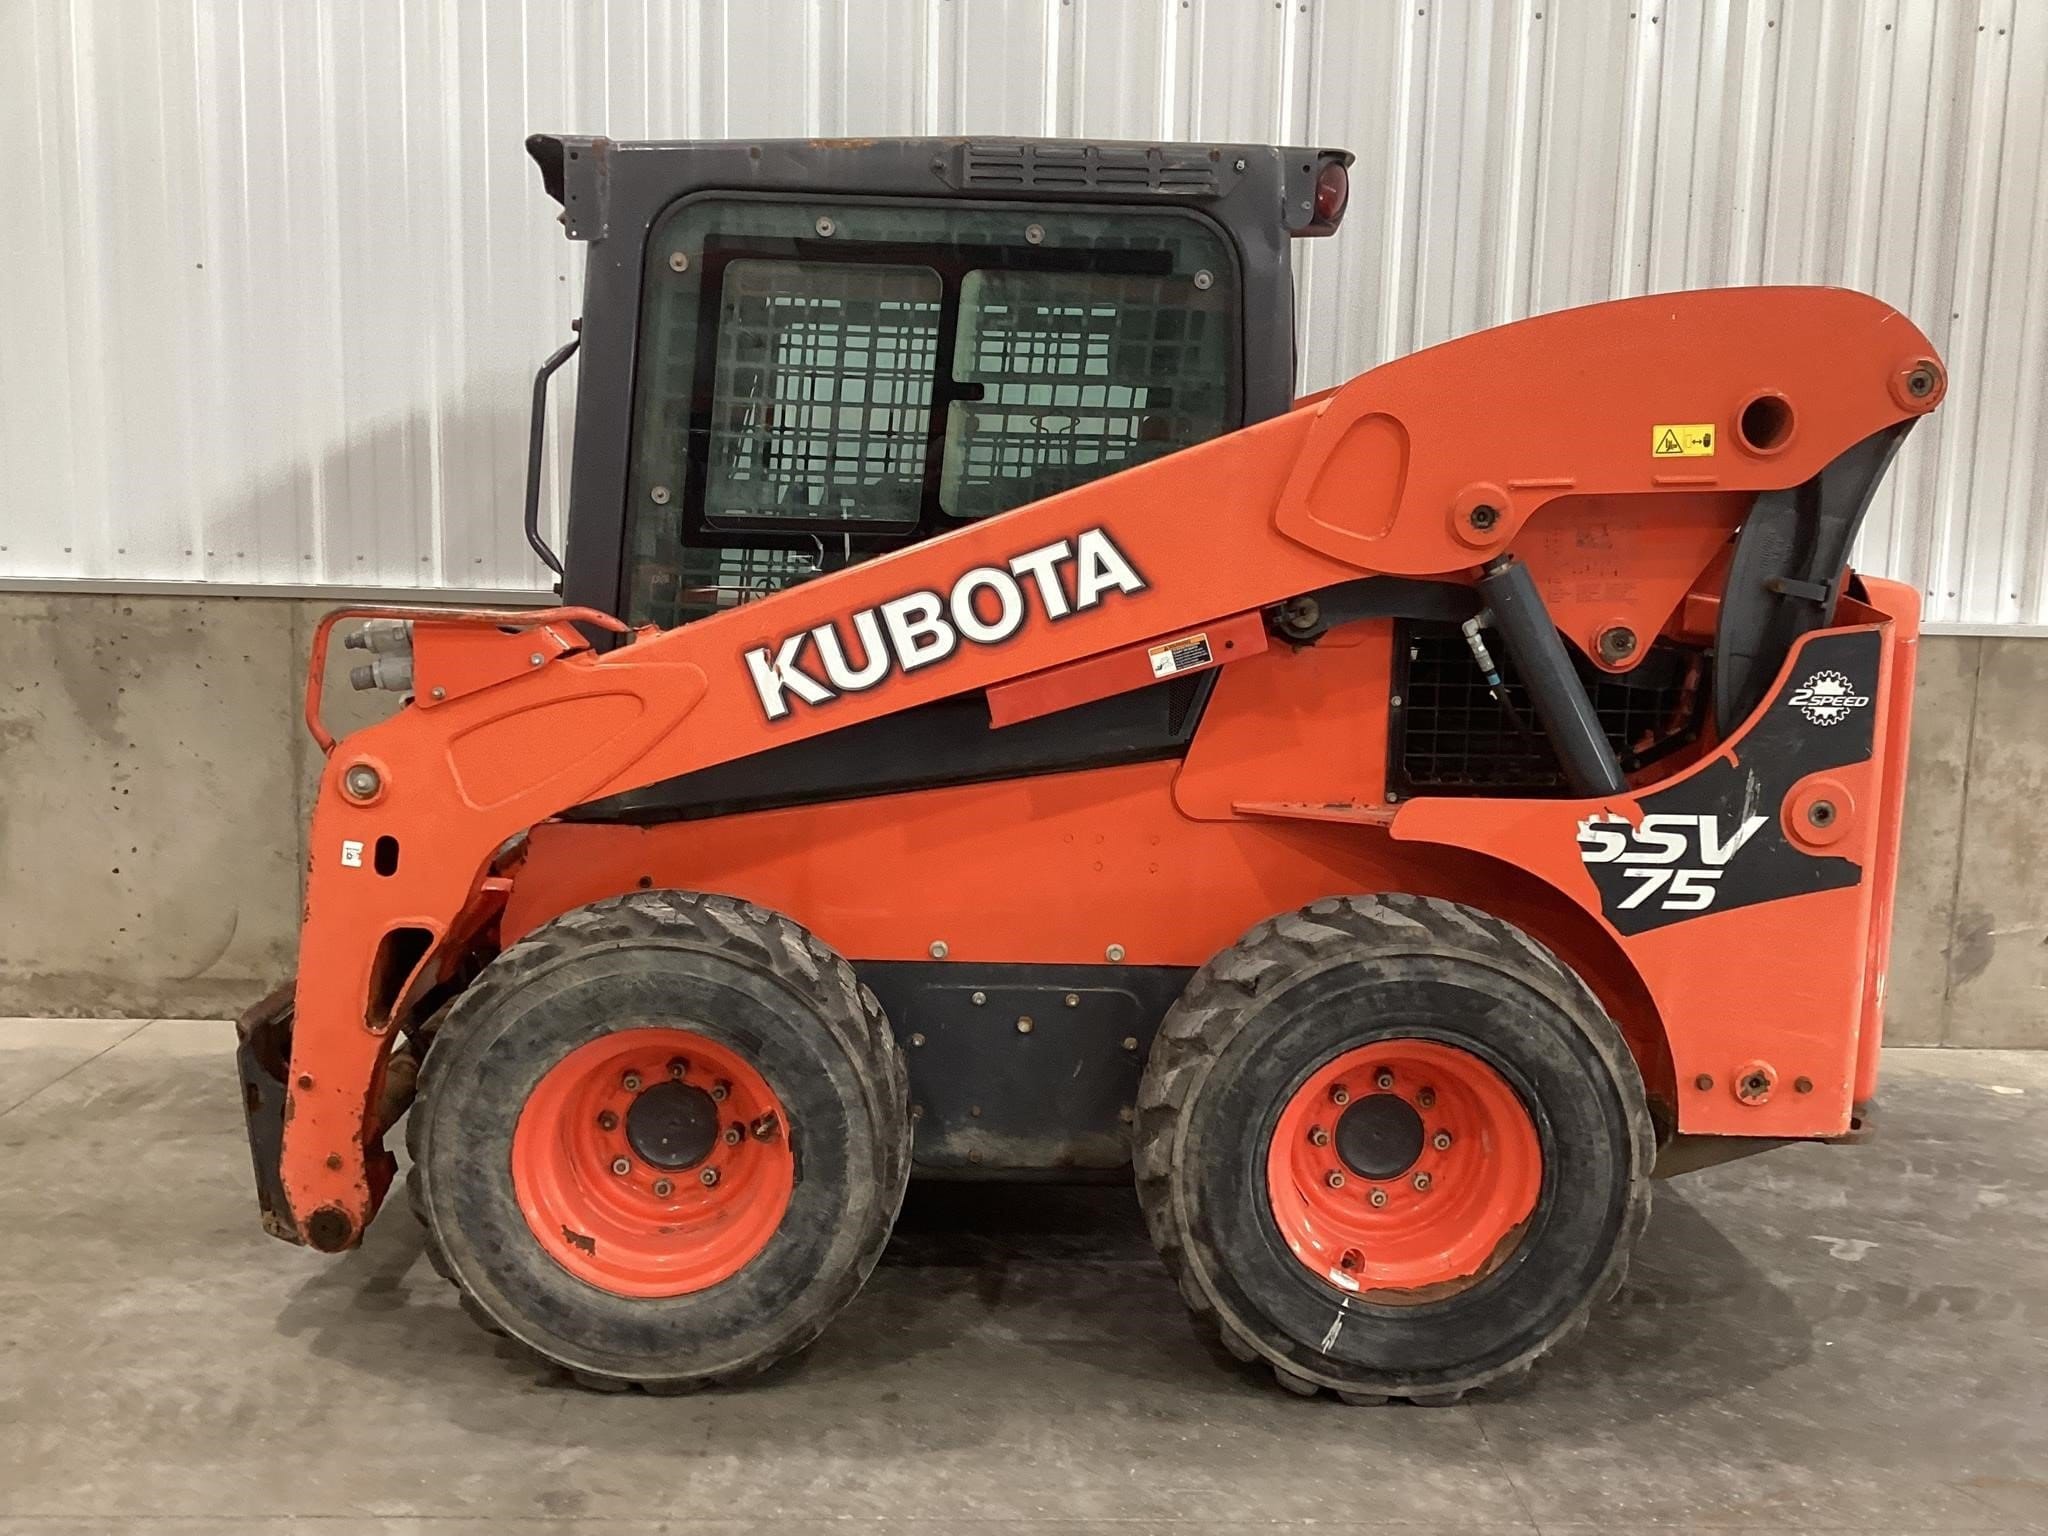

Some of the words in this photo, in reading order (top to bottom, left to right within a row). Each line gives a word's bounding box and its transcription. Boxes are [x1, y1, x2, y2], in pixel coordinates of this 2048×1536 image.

[744, 527, 1146, 720] KUBOTA
[1576, 813, 1769, 865] SSV
[1617, 868, 1724, 910] 75
